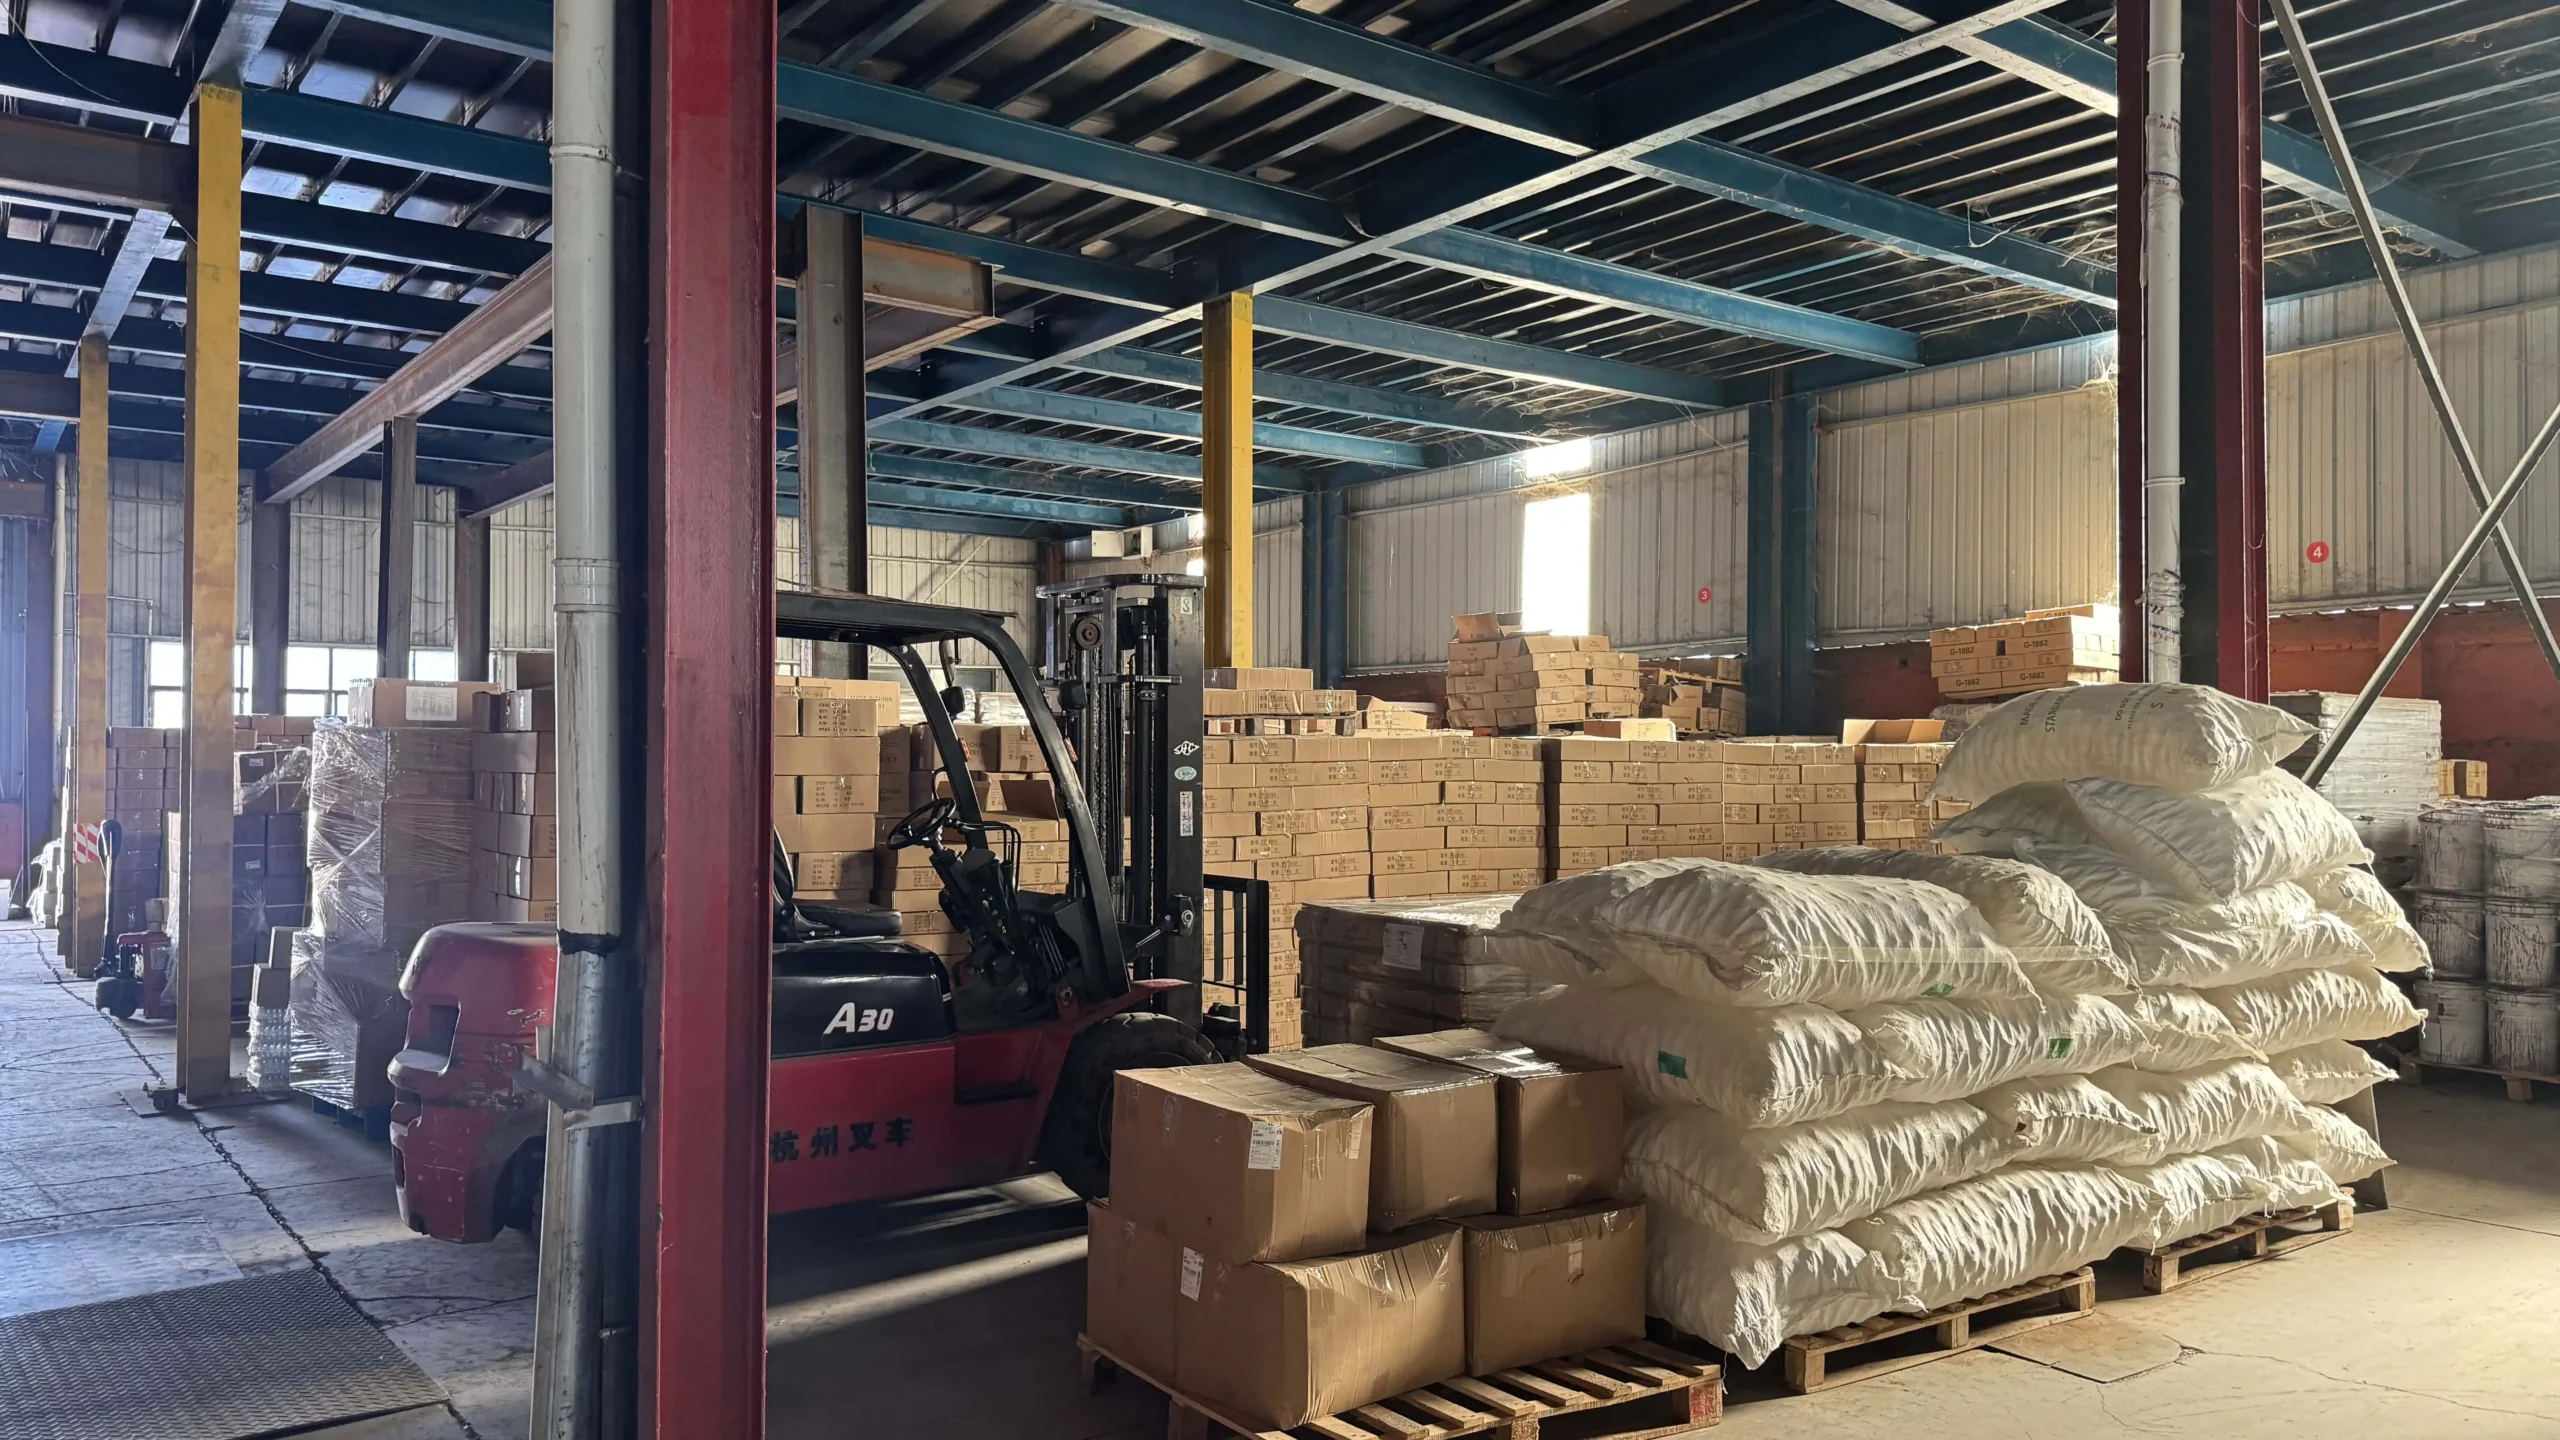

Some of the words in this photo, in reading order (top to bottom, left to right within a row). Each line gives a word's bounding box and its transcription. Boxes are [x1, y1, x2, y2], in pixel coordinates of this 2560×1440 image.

[2312, 545, 2323, 559] 4
[1701, 590, 1708, 600] 3
[2023, 639, 2049, 649] G-1882
[1949, 646, 1975, 656] G-1882
[2019, 671, 2046, 681] G-1882
[1955, 678, 1980, 687] G-1882
[770, 1116, 914, 1163] 杭州叉车
